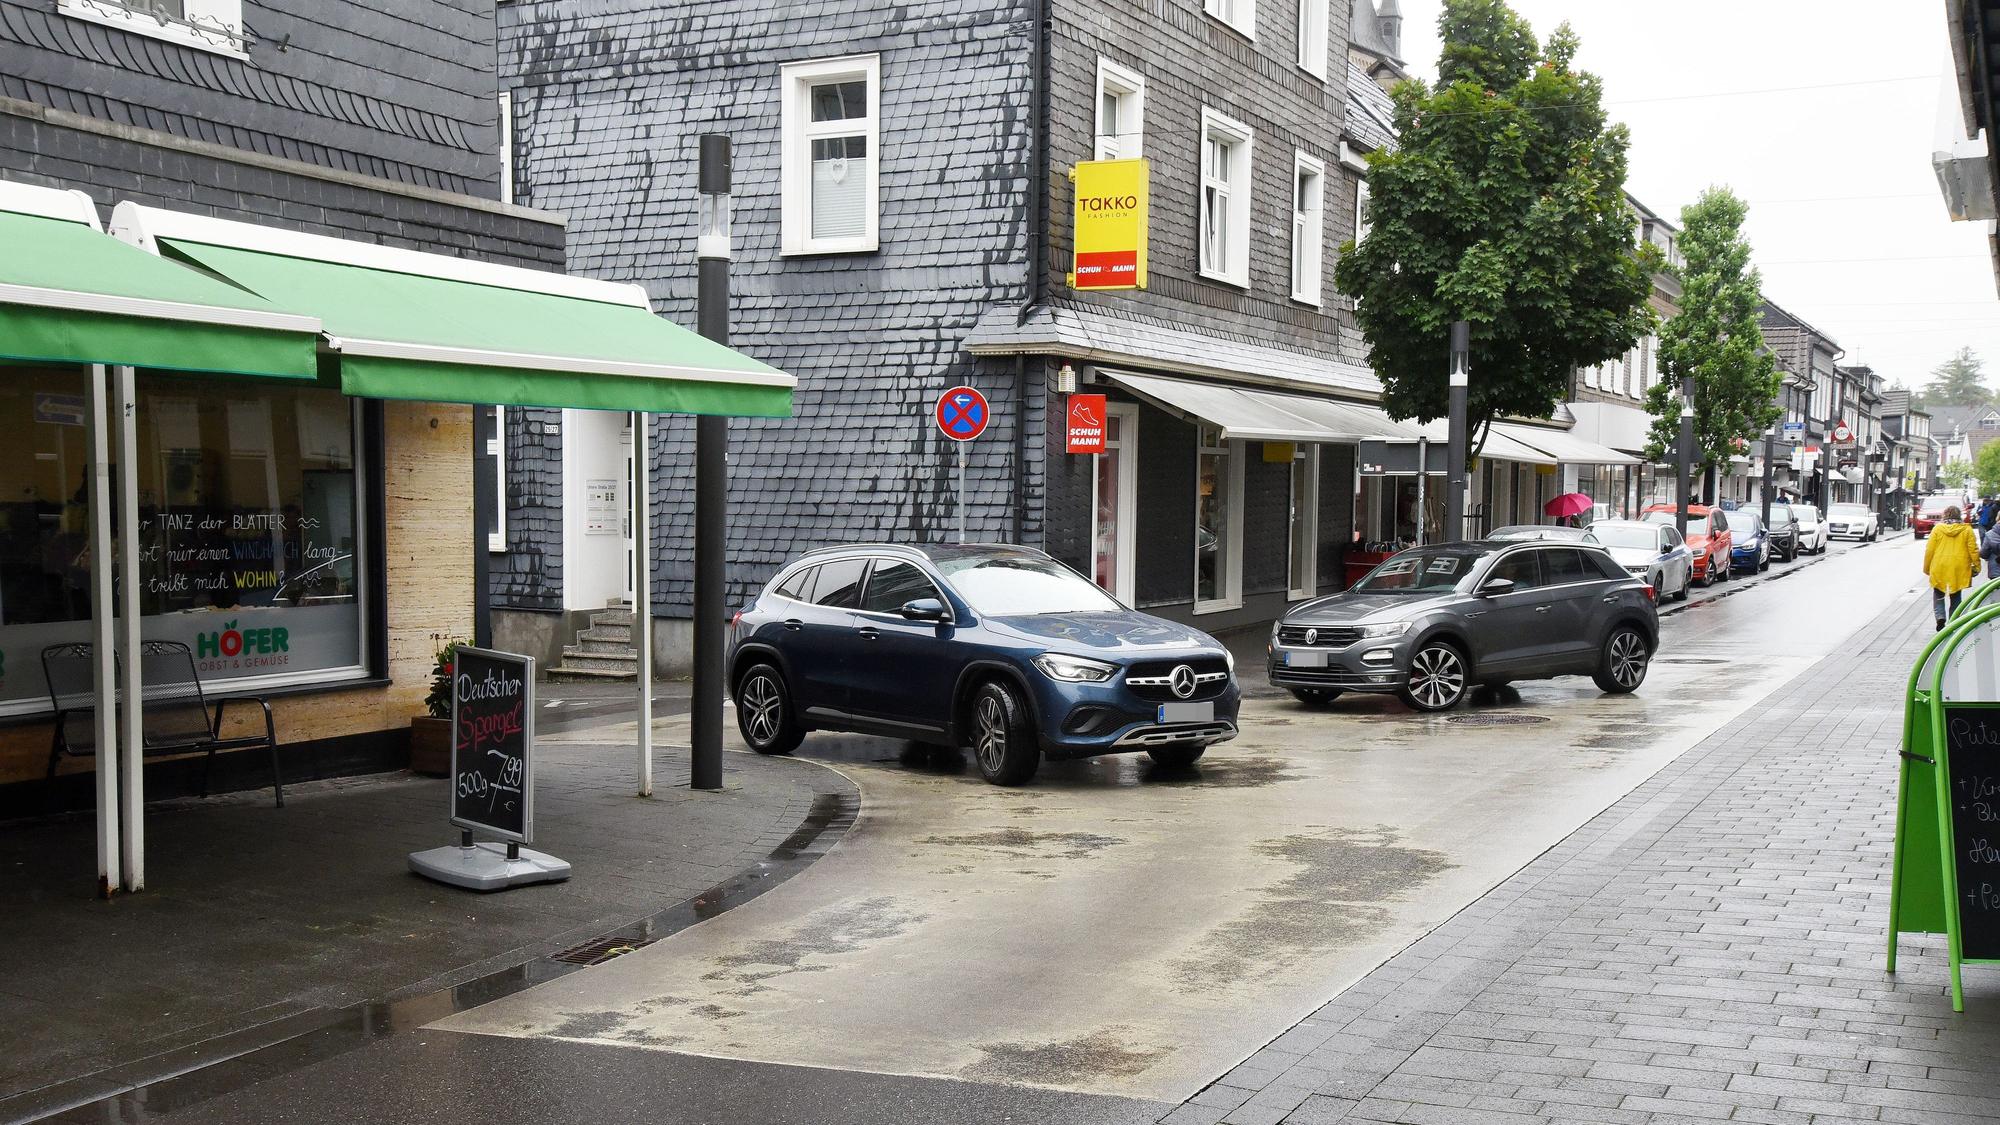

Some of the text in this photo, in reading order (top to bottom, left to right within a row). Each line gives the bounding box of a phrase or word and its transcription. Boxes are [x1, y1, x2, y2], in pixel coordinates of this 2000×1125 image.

[1076, 264, 1135, 274] SCHUH MANN
[1069, 427, 1101, 436] SCHUH
[1070, 437, 1100, 446] MANN
[158, 513, 194, 530] TANZ
[198, 513, 228, 530] der
[232, 514, 287, 530] BLÄTTER
[198, 543, 231, 562] einen
[148, 570, 189, 593] treibt
[194, 571, 229, 590] mich
[197, 619, 289, 659] HÖFER
[200, 655, 289, 672] OBST & GEMÜSE
[457, 668, 522, 703] Deutscher
[459, 700, 522, 751] Spargel
[1950, 717, 2000, 748] Pute
[458, 770, 488, 798] 500g
